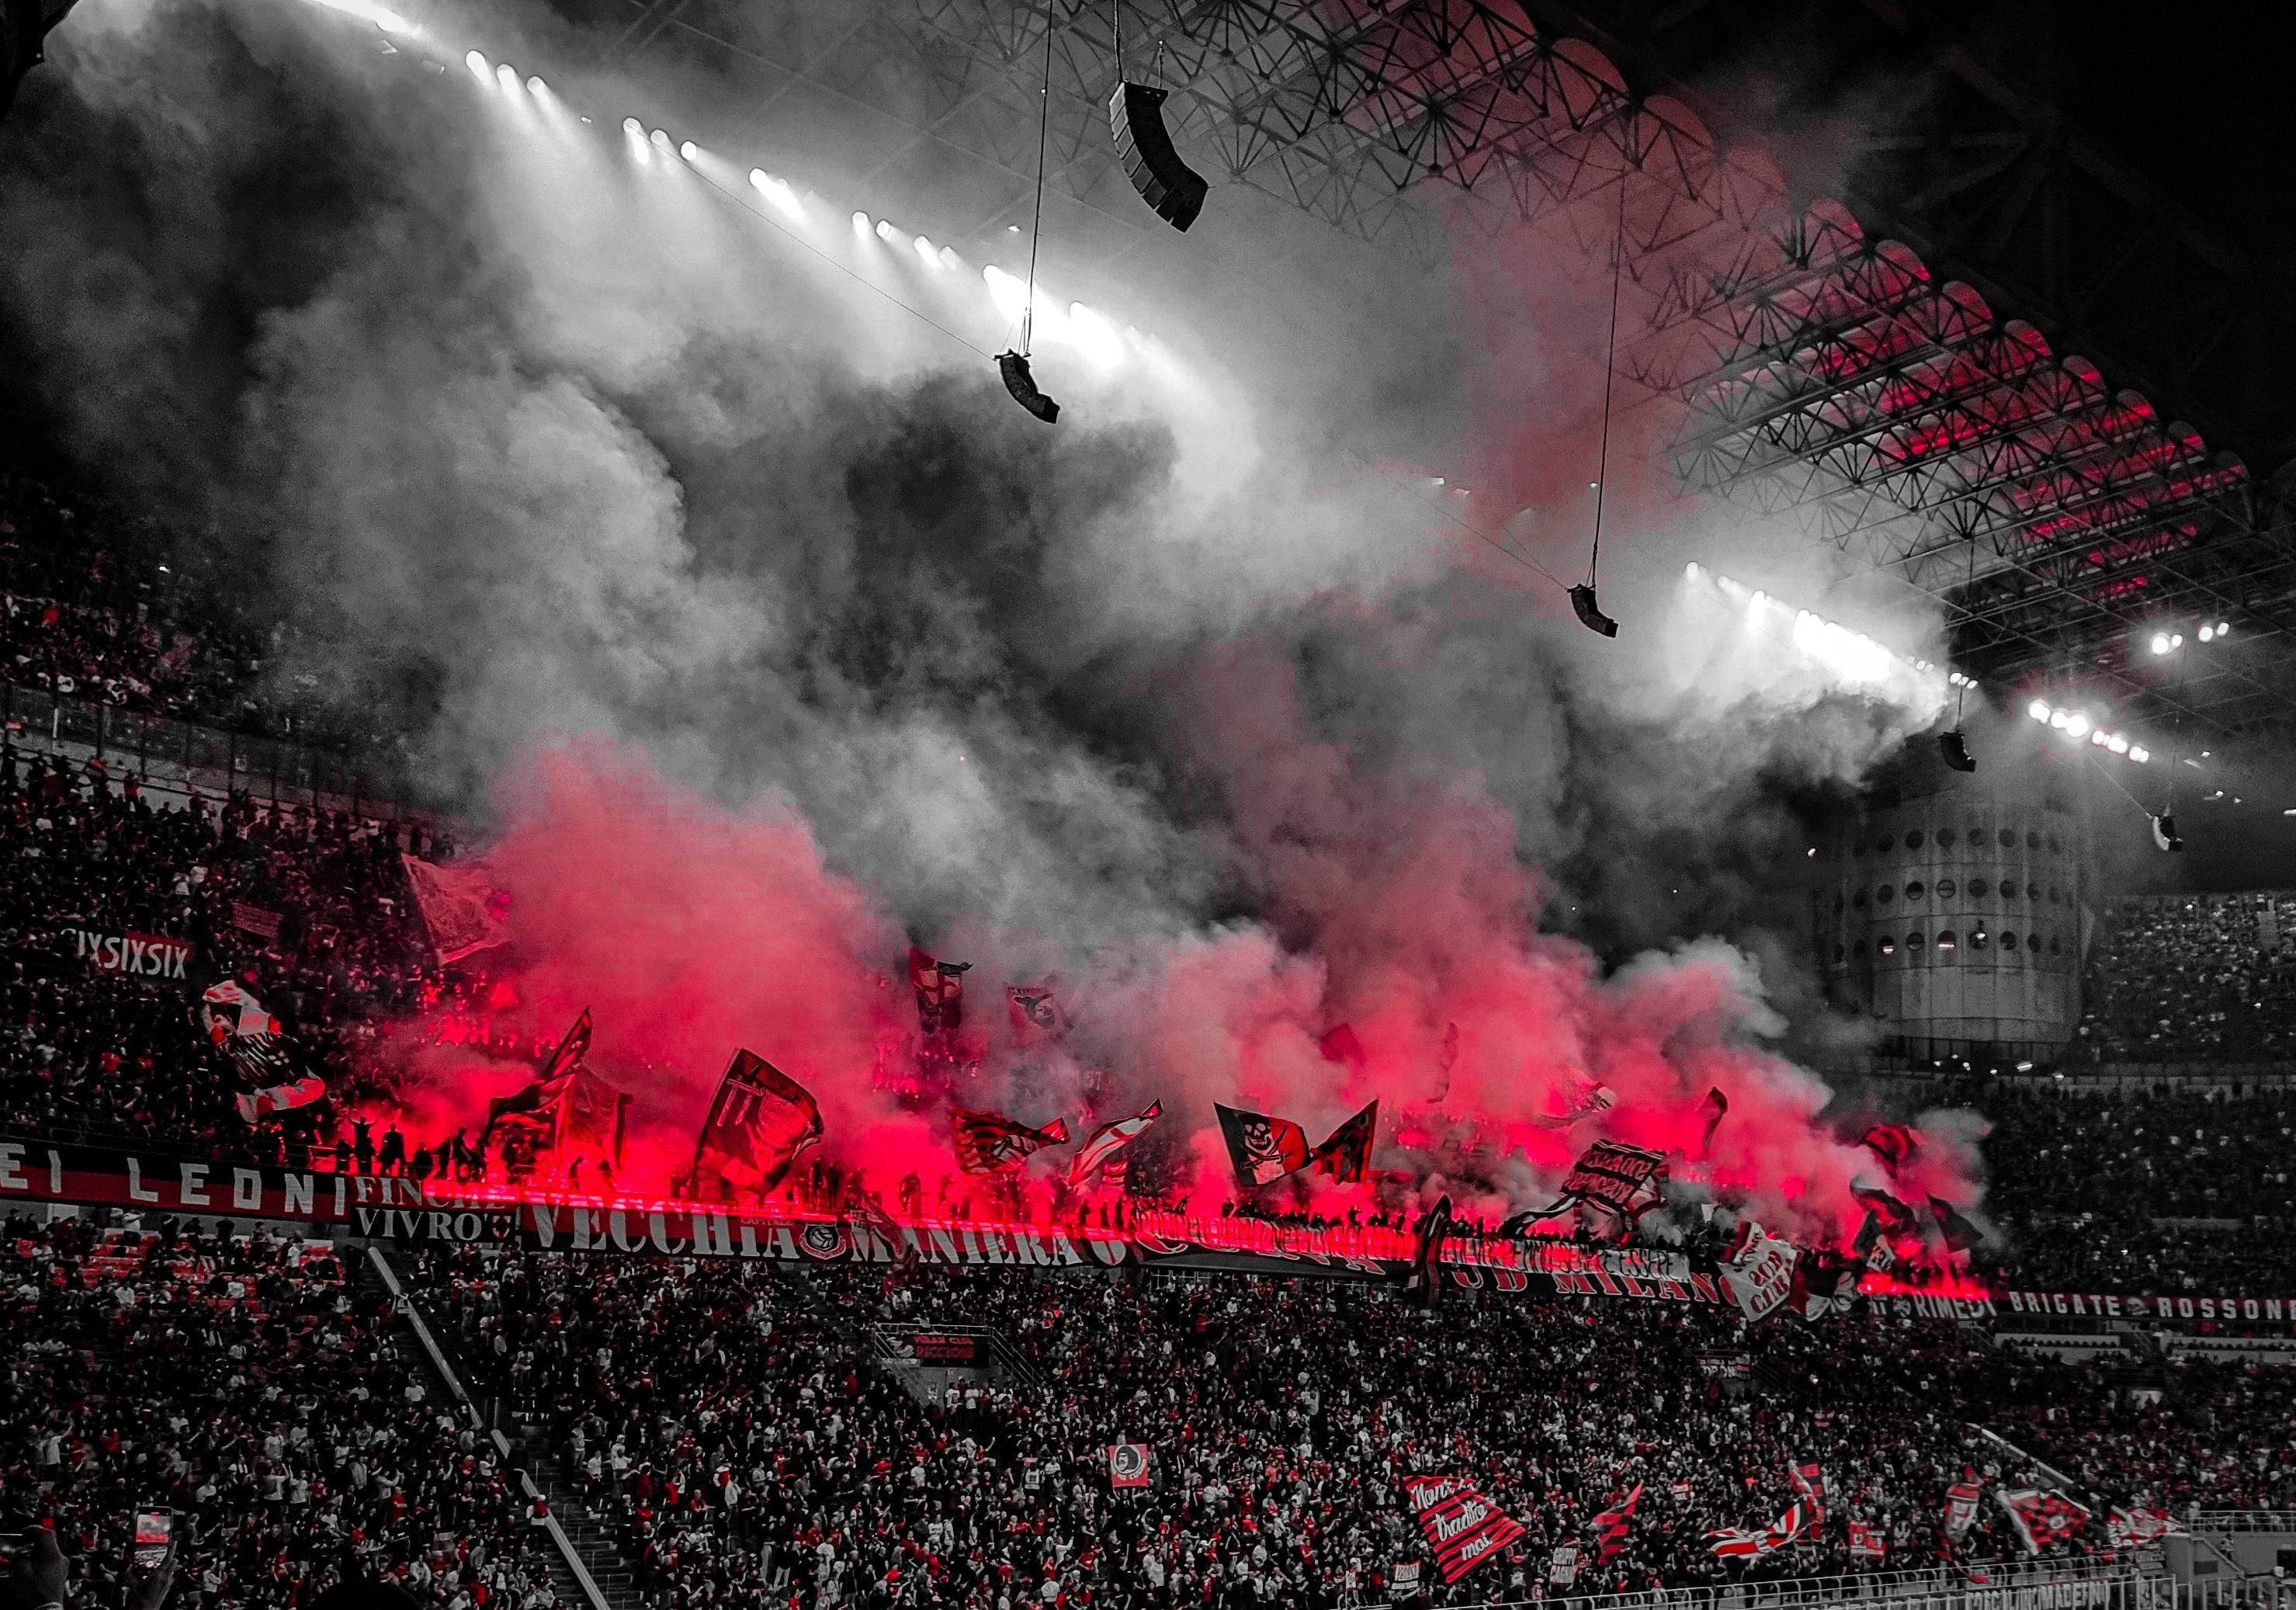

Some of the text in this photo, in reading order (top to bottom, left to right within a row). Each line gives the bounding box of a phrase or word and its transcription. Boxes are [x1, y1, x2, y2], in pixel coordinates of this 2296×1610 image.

[60, 928, 188, 980] IXSIXSIX
[127, 1157, 345, 1216] LEONI
[530, 1194, 801, 1259] VECCHIA
[2008, 1291, 2121, 1317] BRIGATE
[1431, 1500, 1488, 1542] tradito
[1462, 1532, 1493, 1561] mai
